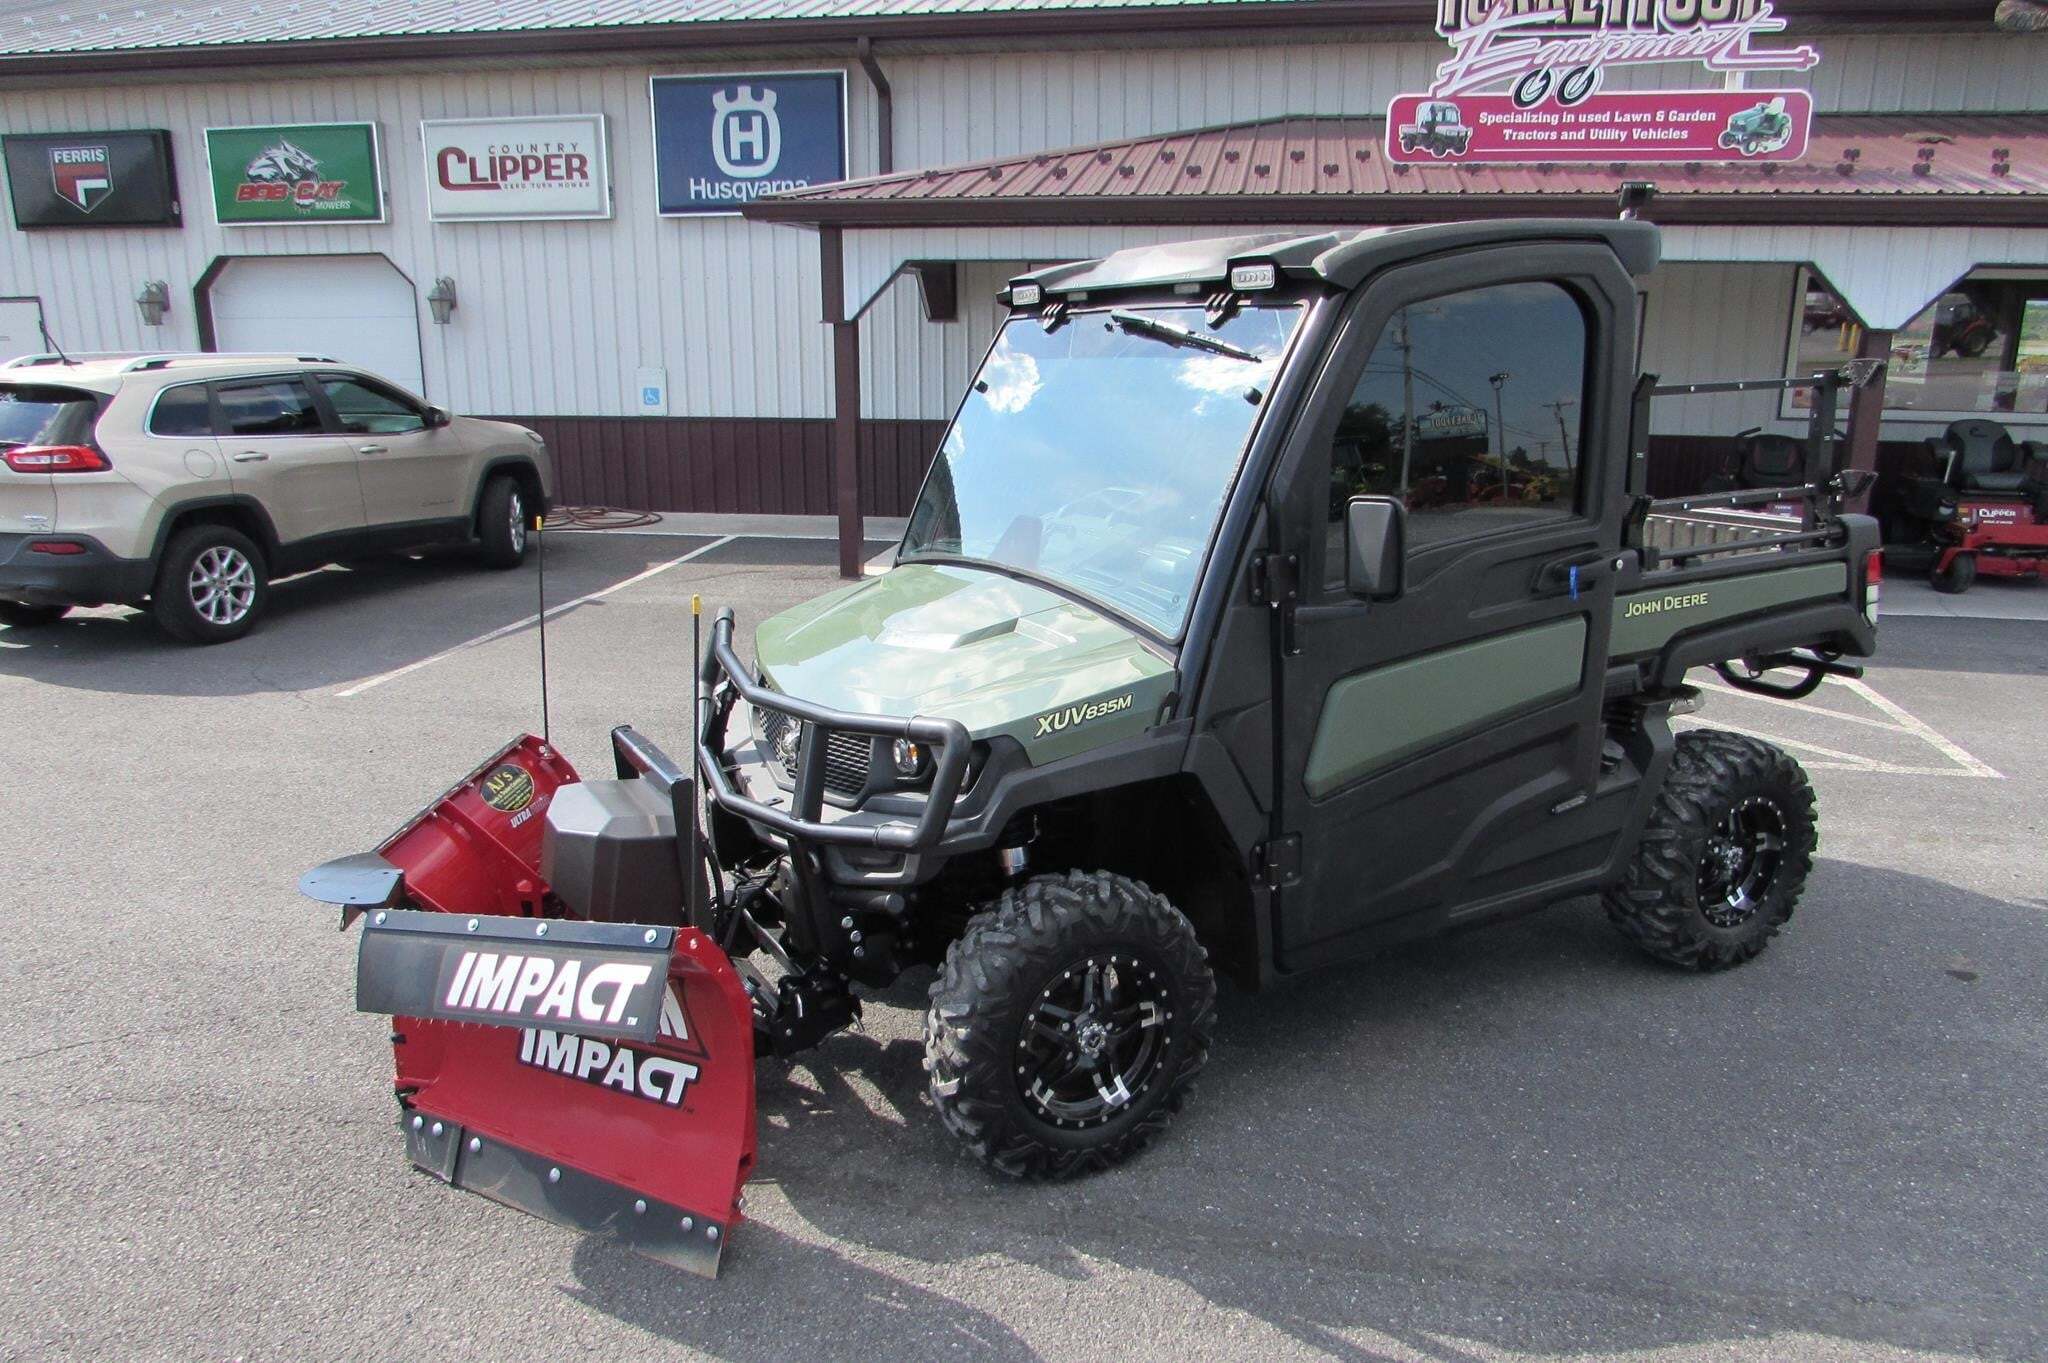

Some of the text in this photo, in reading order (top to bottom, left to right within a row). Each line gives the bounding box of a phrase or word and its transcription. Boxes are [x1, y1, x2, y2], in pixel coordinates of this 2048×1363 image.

[1436, 4, 1806, 98] Equipment
[1479, 110, 1716, 125] Specializing in used Lawn & Garden
[1503, 128, 1689, 142] Tractors and Utility Vehicles
[53, 149, 106, 163] FERRIS
[488, 142, 579, 155] COUNTRY
[437, 147, 589, 191] CLIPPER
[315, 200, 352, 210] MOWERS
[1624, 592, 1709, 618] JOHN DEERE
[1035, 694, 1133, 737] XUV835M
[446, 951, 653, 1024] IMPACT
[520, 1027, 699, 1104] IMPACT
